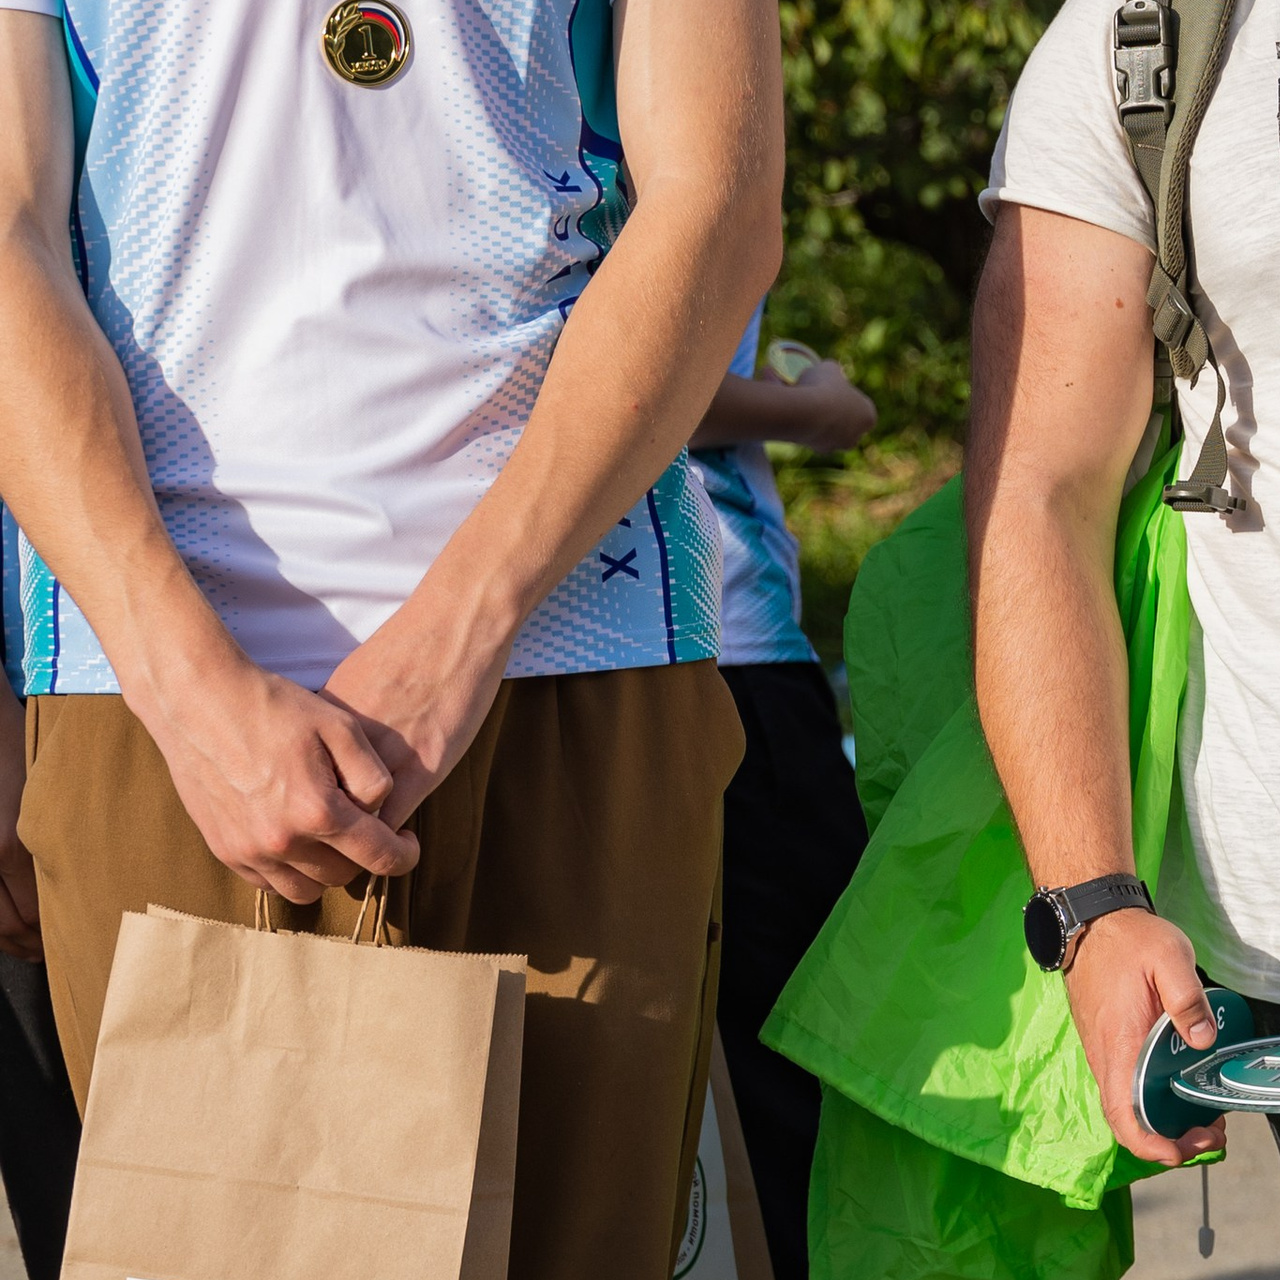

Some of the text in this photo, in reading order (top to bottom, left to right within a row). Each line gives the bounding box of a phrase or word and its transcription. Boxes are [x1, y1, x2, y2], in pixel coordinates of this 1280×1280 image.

[358, 25, 377, 59] 1
[1217, 1005, 1225, 1030] 3
[688, 1191, 700, 1246] помощи
